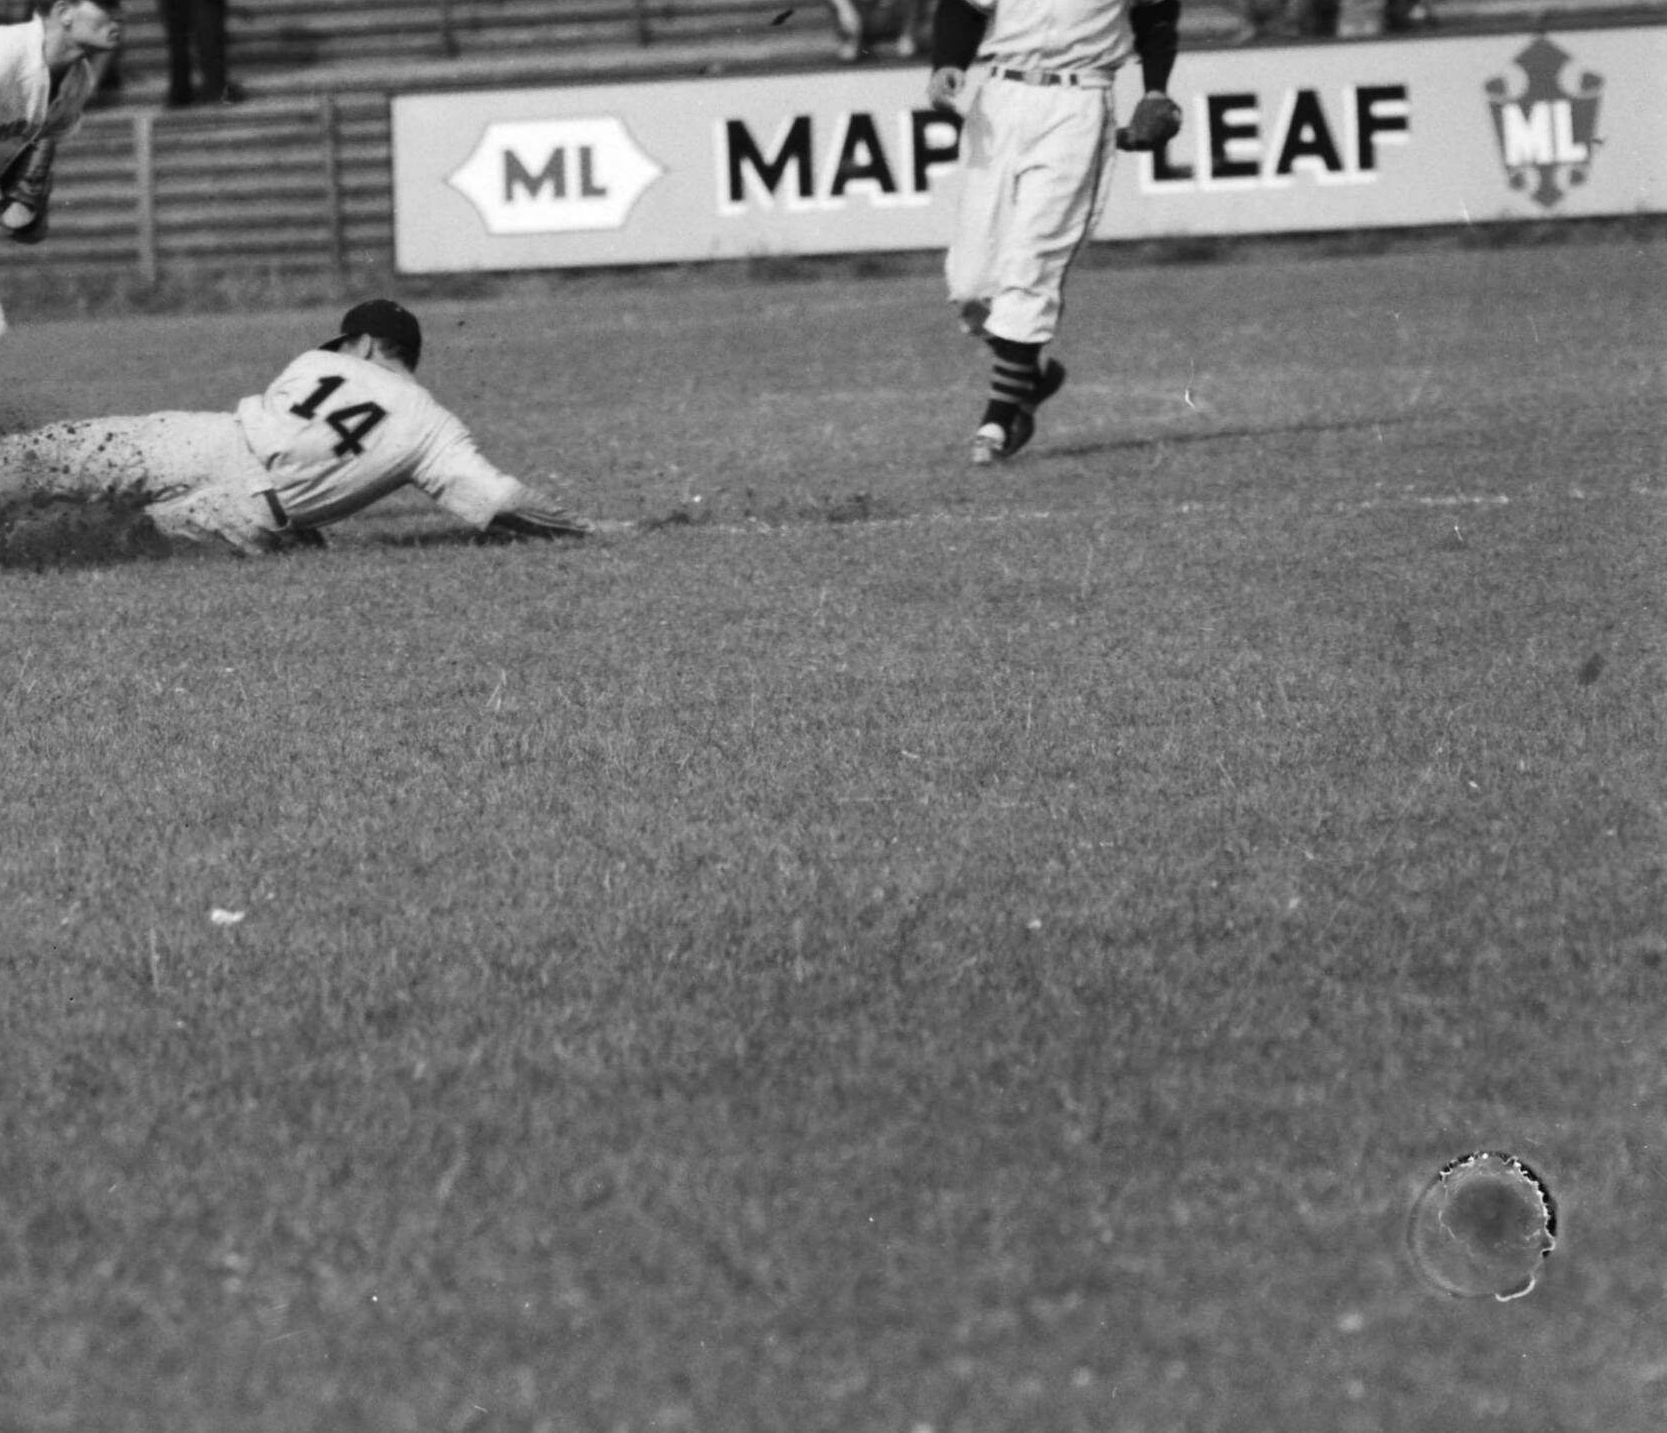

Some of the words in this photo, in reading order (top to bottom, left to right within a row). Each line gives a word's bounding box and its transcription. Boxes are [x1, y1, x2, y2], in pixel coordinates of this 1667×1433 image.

[727, 109, 963, 202] MAP
[1503, 99, 1589, 169] ML
[503, 145, 607, 202] ML
[289, 374, 389, 459] 14
